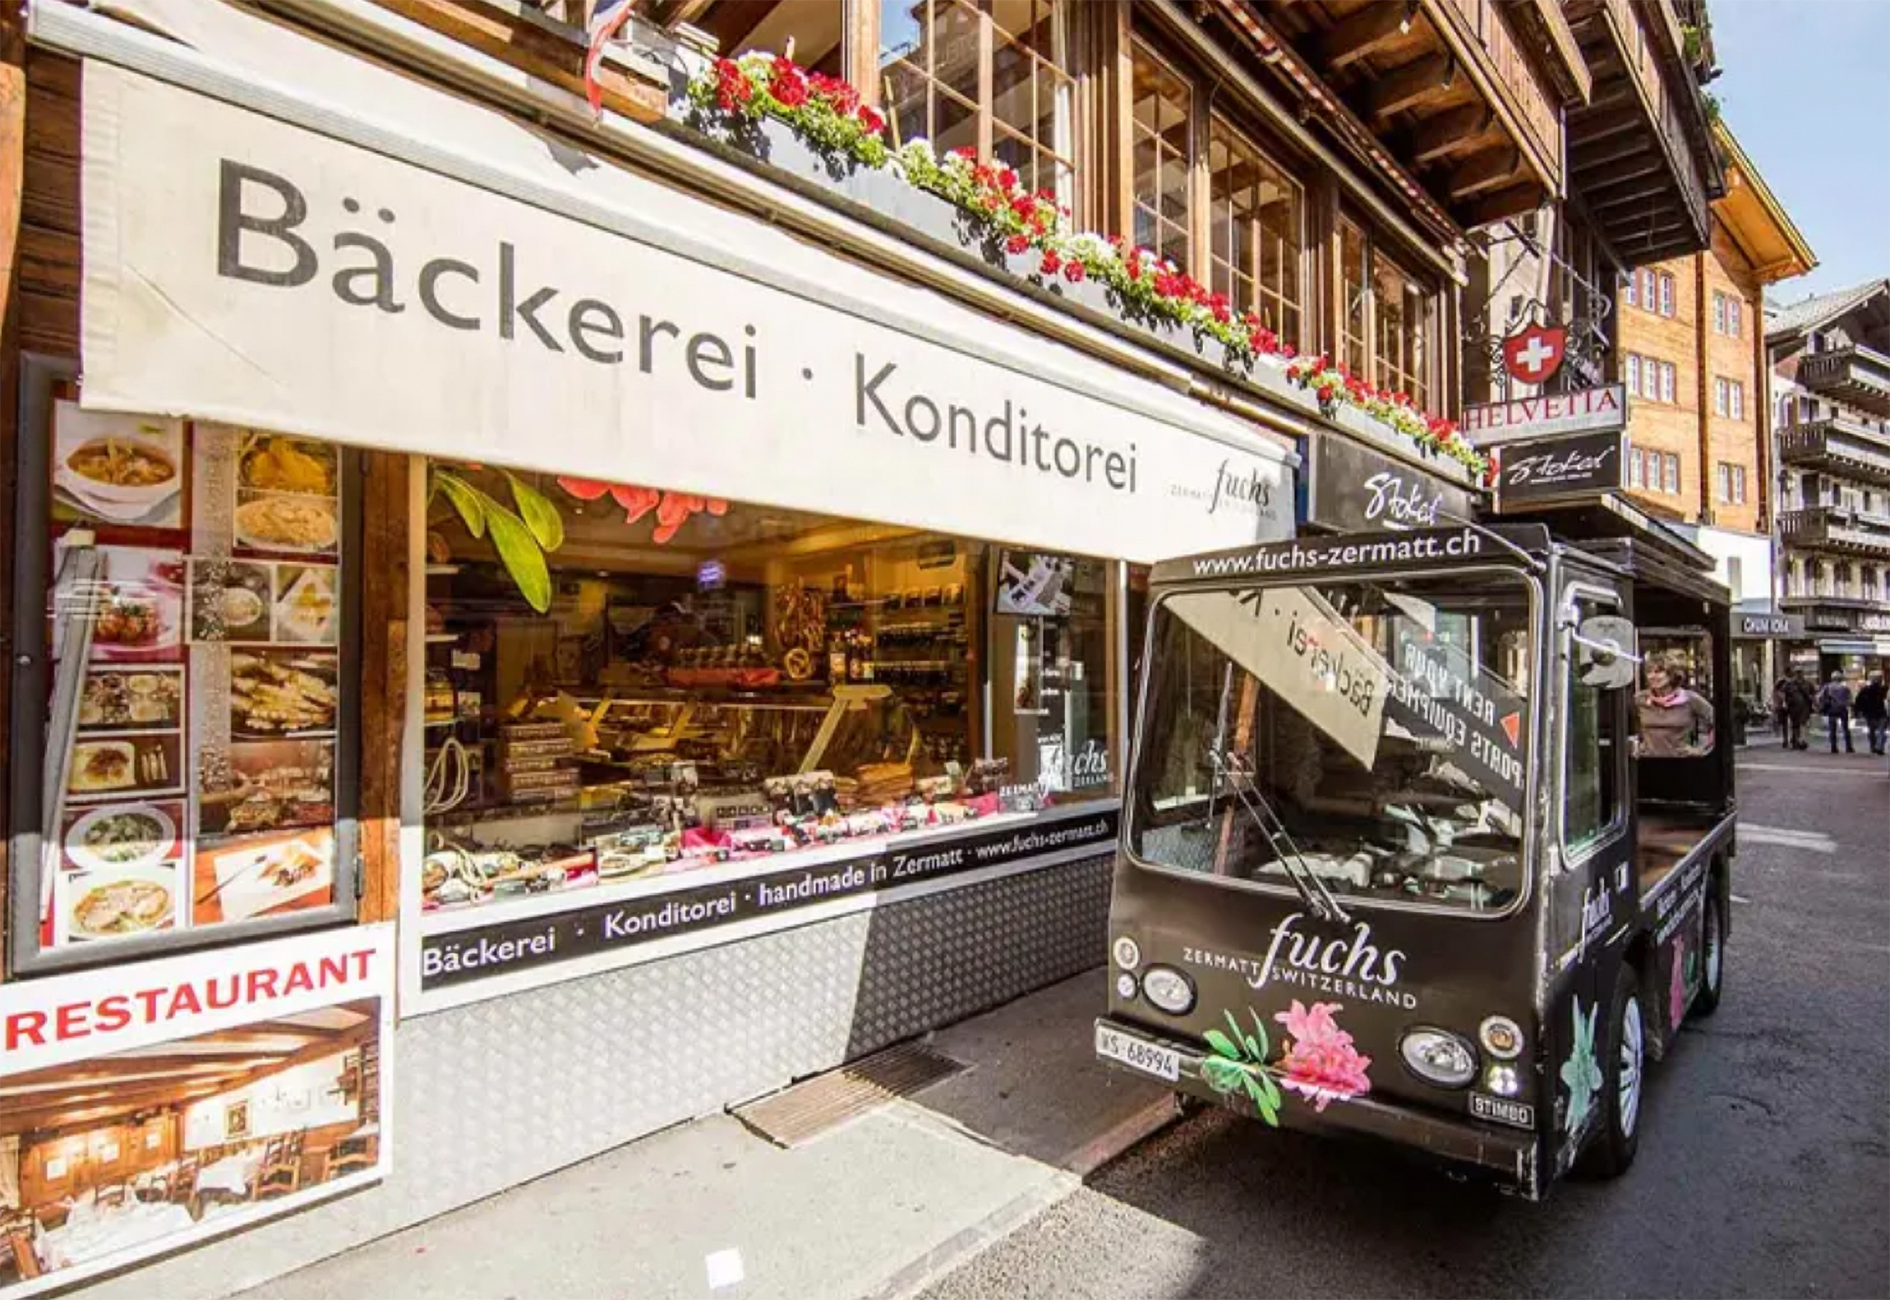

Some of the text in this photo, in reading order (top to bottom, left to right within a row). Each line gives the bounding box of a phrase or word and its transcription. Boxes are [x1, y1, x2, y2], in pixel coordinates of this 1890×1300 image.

[217, 157, 1138, 494] Bäckerei Konditorei
[1461, 387, 1618, 430] HELVETIA
[1205, 457, 1269, 515] fuchs
[1193, 529, 1481, 576] www.fuchs-zermatt.ch
[422, 927, 556, 977] Bäckerei
[604, 892, 737, 939] Konditorei
[758, 865, 866, 907] handmade
[871, 864, 887, 883] in
[893, 848, 964, 877] Zermatt
[1182, 947, 1417, 1010] ZERMATT SWITZERLAND
[1246, 912, 1407, 989] fuchs
[5, 948, 377, 1051] RESTAURANT
